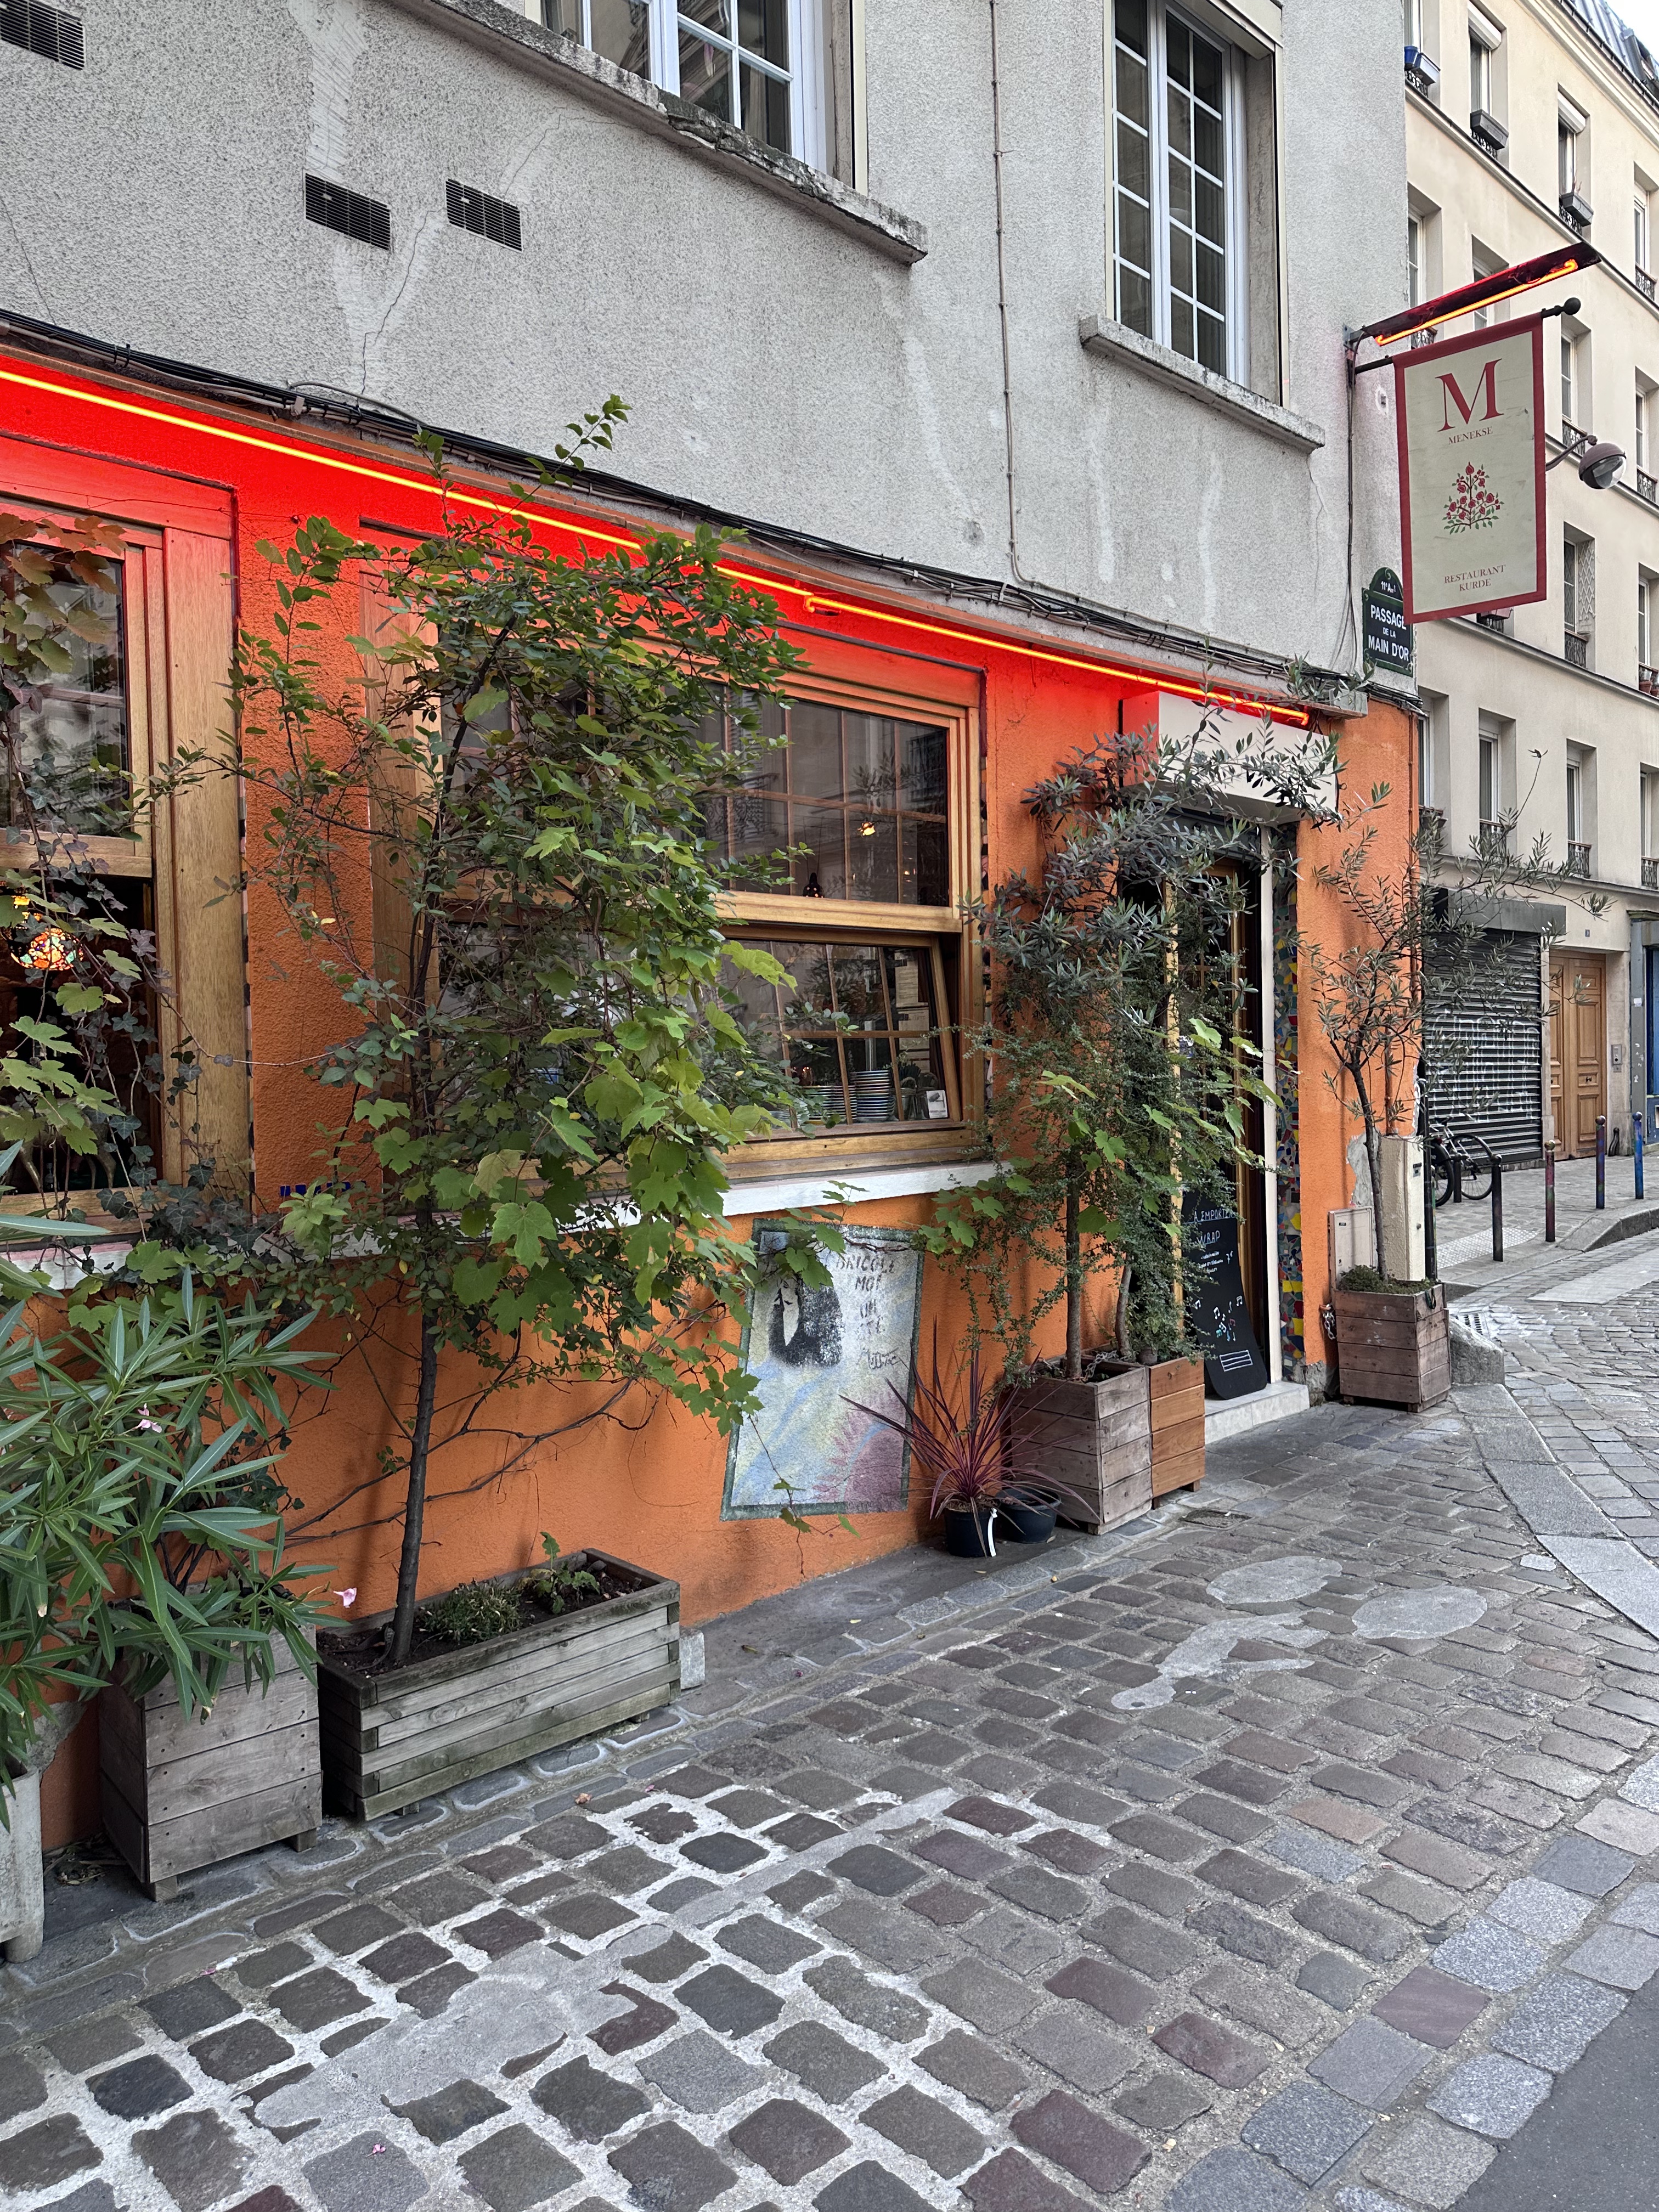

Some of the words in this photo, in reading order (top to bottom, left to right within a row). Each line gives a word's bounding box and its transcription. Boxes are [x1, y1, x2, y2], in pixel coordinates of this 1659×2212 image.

[1435, 358, 1504, 432] M
[1448, 426, 1494, 445] MENEKSE
[1444, 564, 1506, 584] RESTAURANT
[1459, 579, 1492, 592] KURDE
[1383, 627, 1389, 636] DE
[1390, 630, 1396, 639] LA
[1368, 635, 1389, 654] MAIN
[1392, 642, 1409, 662] D'OR
[1197, 1230, 1221, 1244] WRAP
